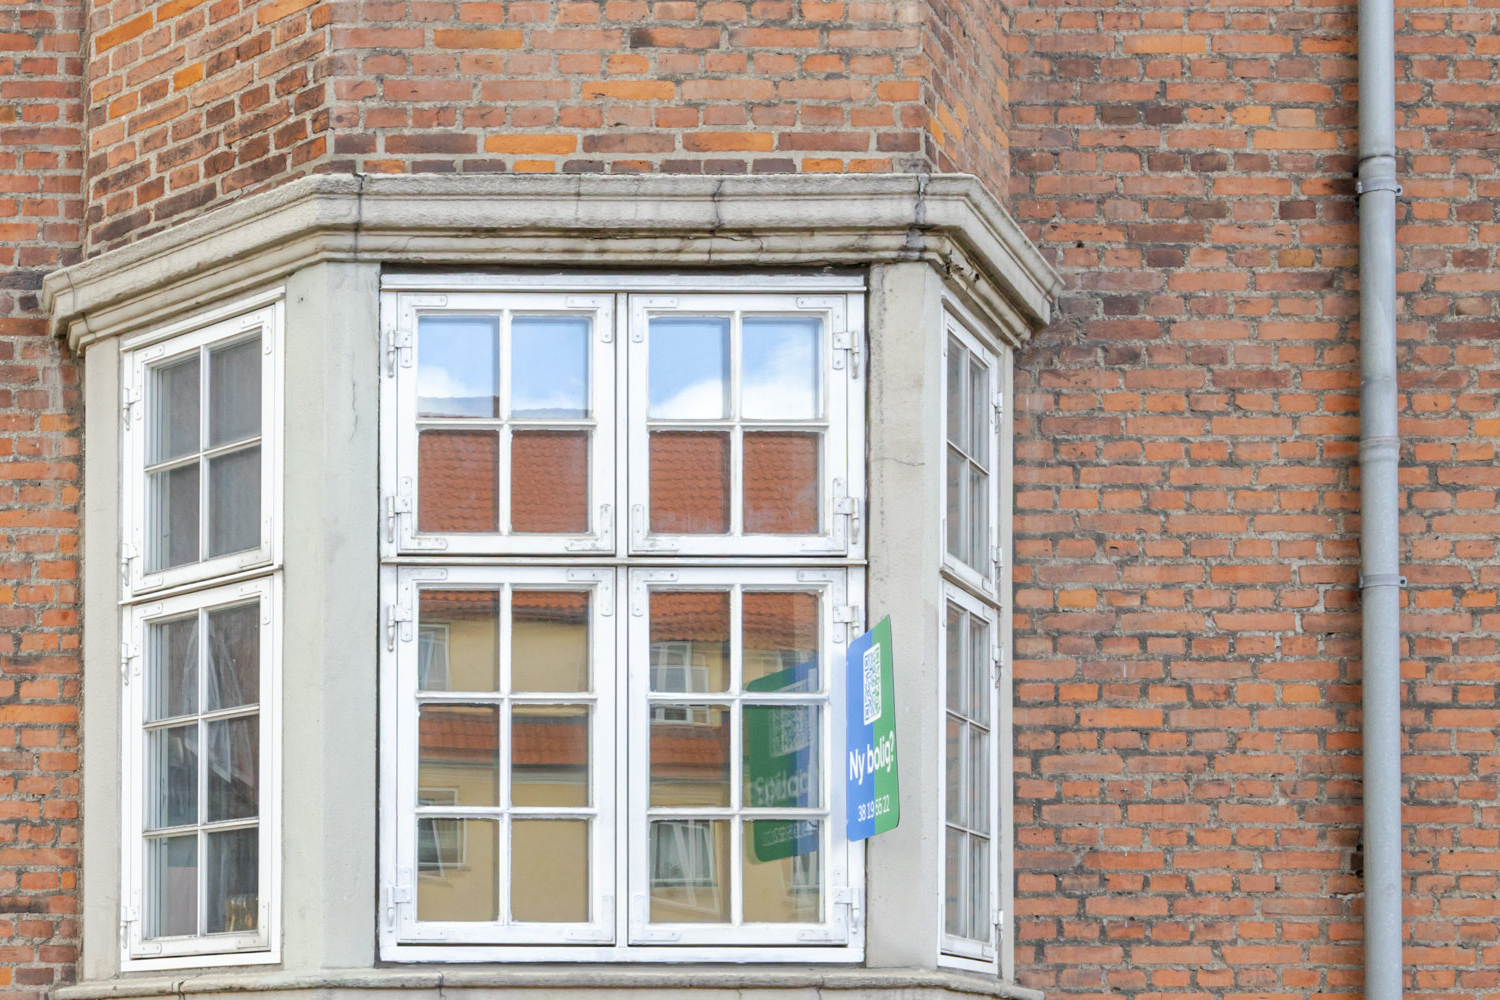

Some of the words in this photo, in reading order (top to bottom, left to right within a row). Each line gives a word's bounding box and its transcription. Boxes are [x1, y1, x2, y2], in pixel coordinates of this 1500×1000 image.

[850, 749, 865, 785] Ny
[867, 731, 894, 773] bolig?
[858, 803, 867, 822] 38
[867, 800, 875, 819] 19
[883, 794, 890, 813] 22
